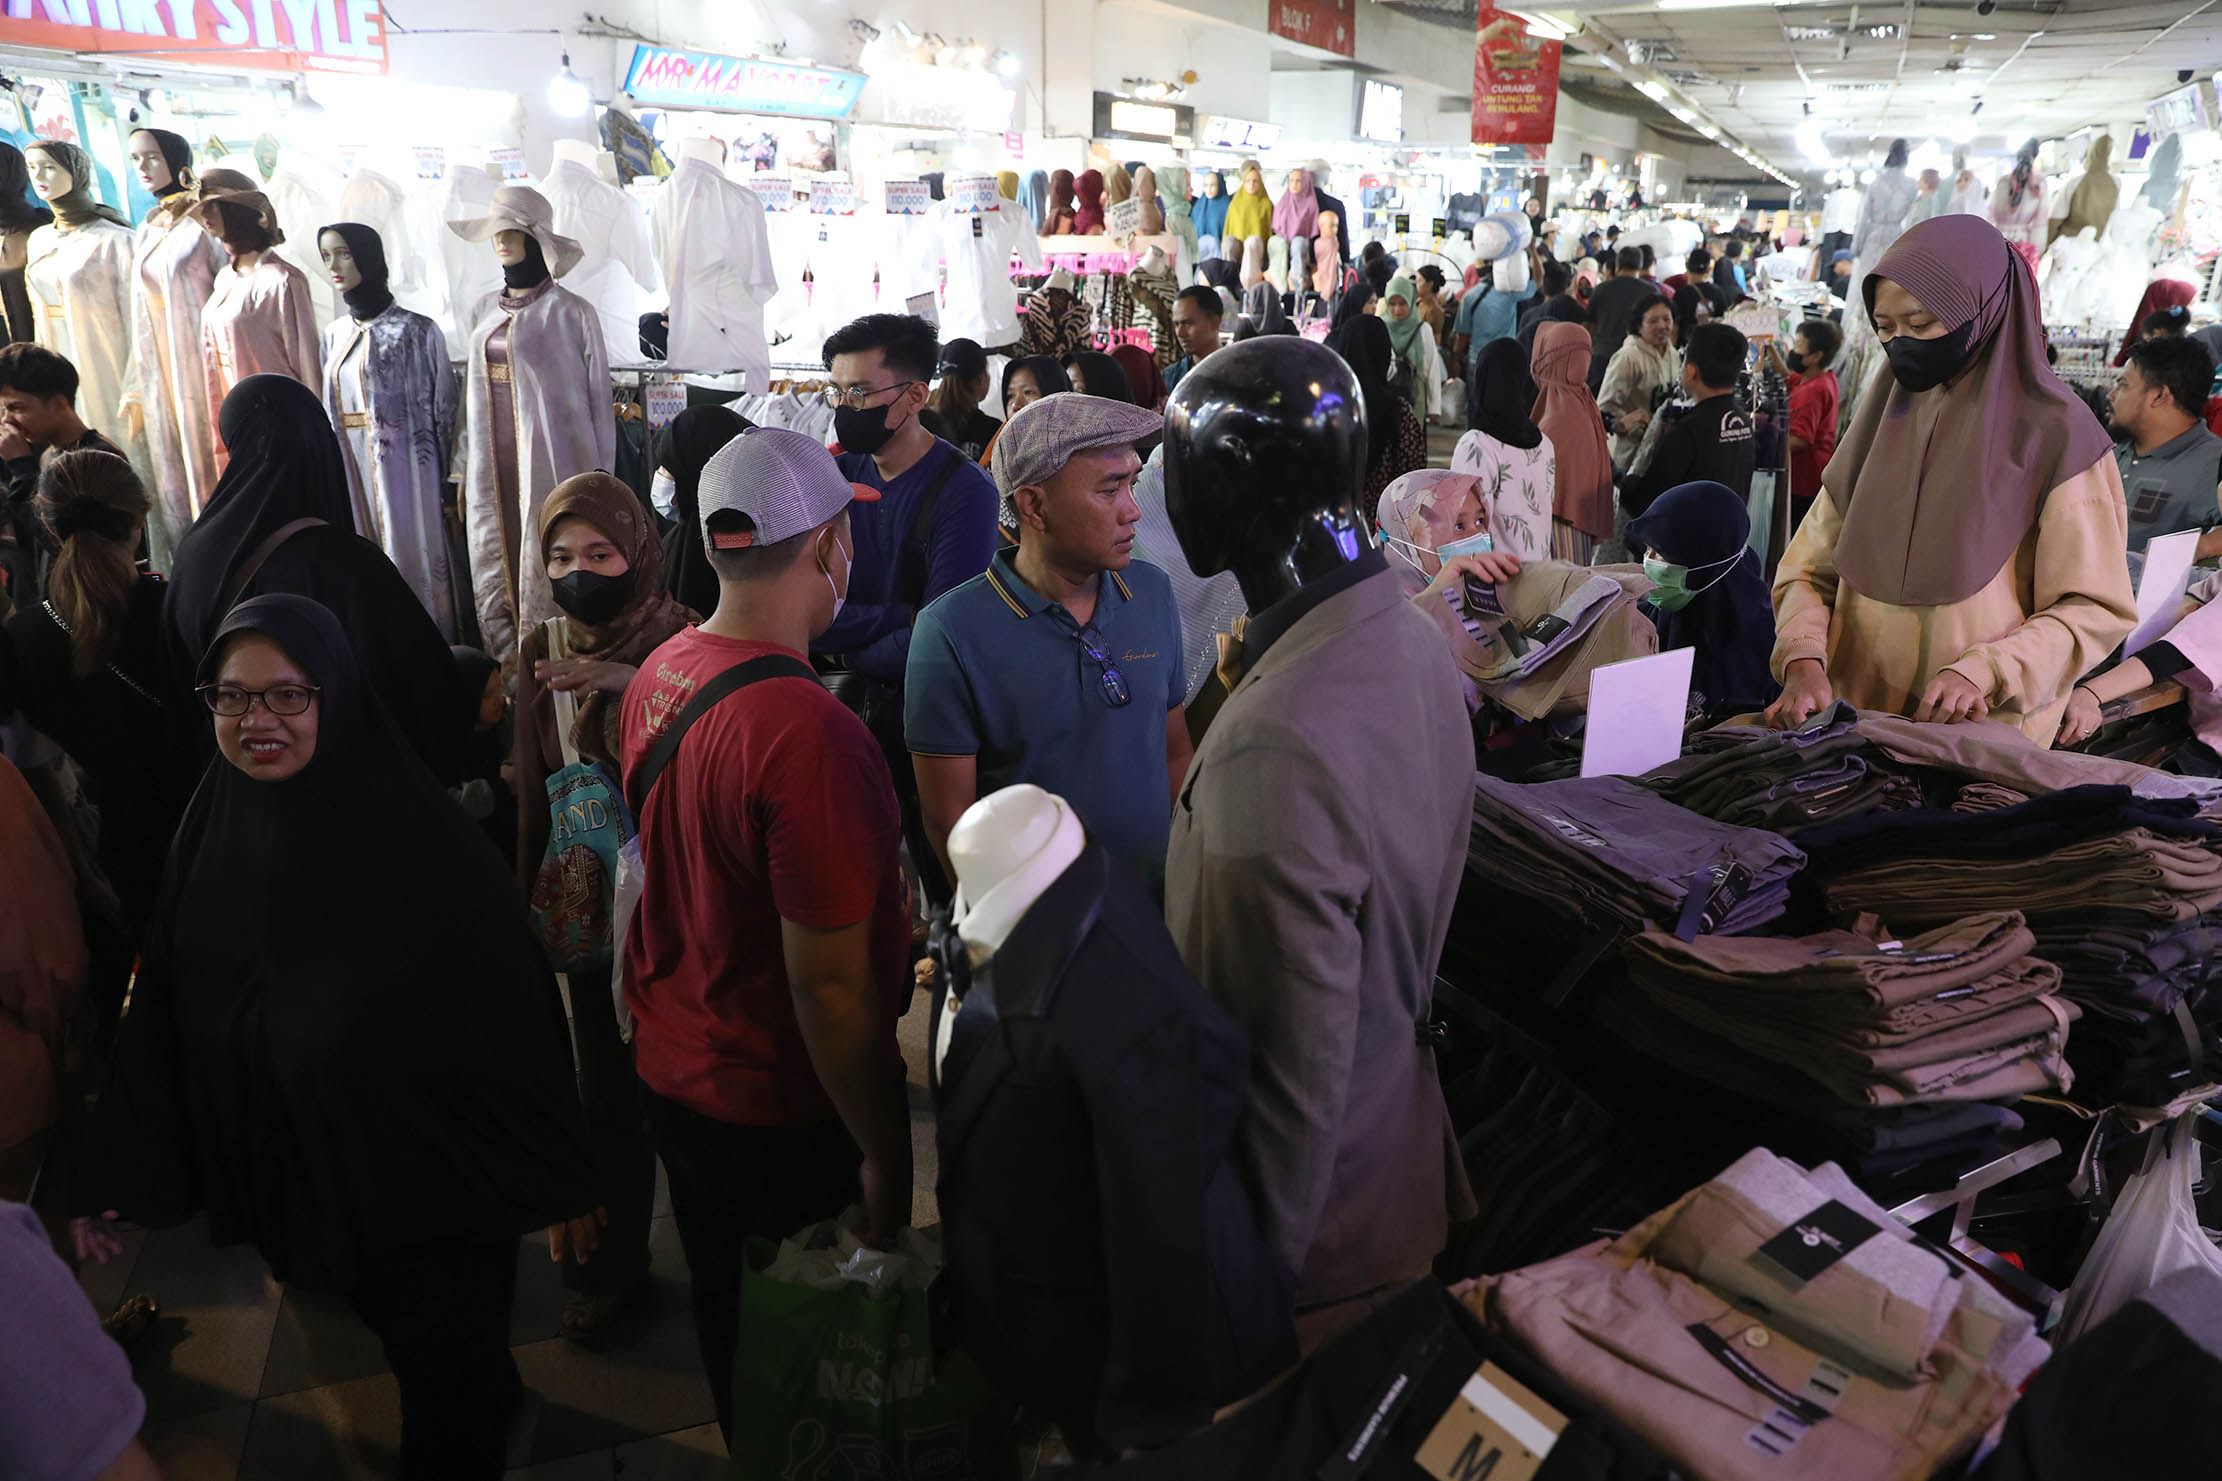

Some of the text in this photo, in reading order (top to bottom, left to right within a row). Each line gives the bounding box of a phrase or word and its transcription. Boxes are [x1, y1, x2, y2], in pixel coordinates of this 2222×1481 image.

[214, 0, 385, 60] STYLE
[1282, 6, 1311, 32] BLOK F
[1482, 94, 1544, 104] UNTUNG TAK
[978, 182, 996, 191] SALE
[891, 195, 925, 205] 110.000
[553, 799, 608, 842] AND
[1449, 1432, 1503, 1481] M
